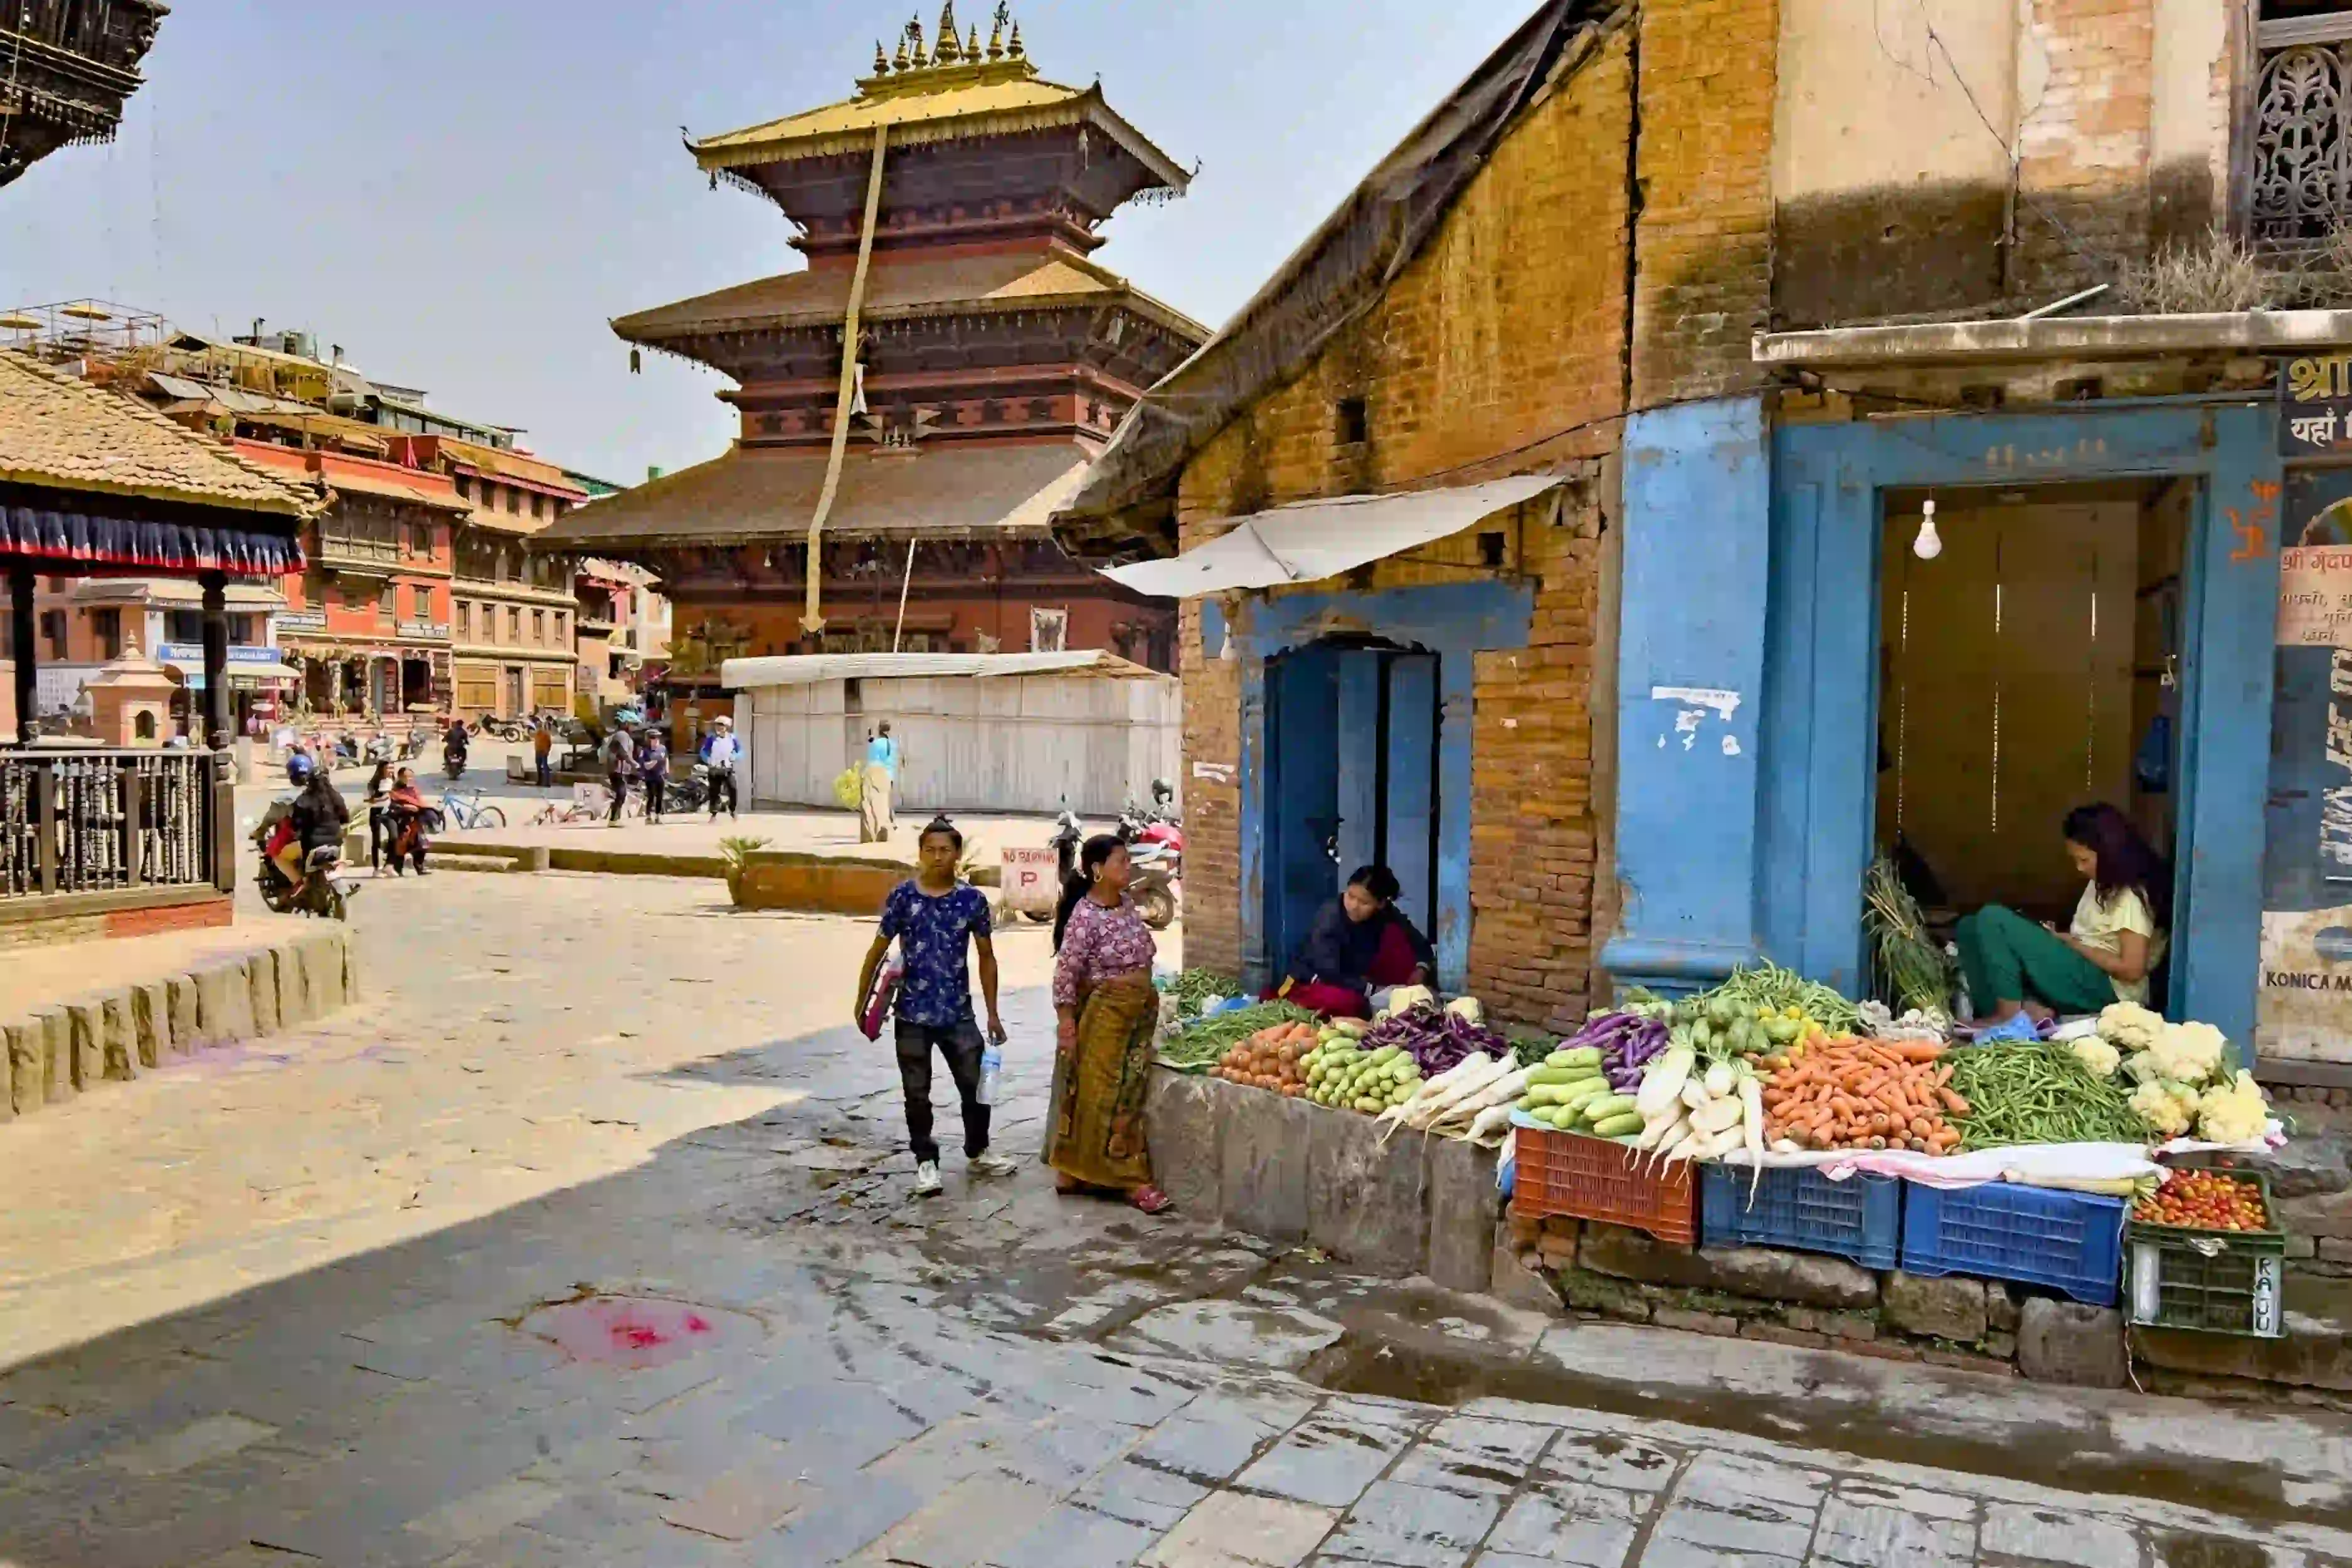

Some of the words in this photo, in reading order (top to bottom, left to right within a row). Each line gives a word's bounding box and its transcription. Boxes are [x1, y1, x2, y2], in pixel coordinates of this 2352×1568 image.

[1003, 851, 1016, 864] NO
[1020, 871, 1038, 887] P
[2266, 972, 2329, 990] KONICA
